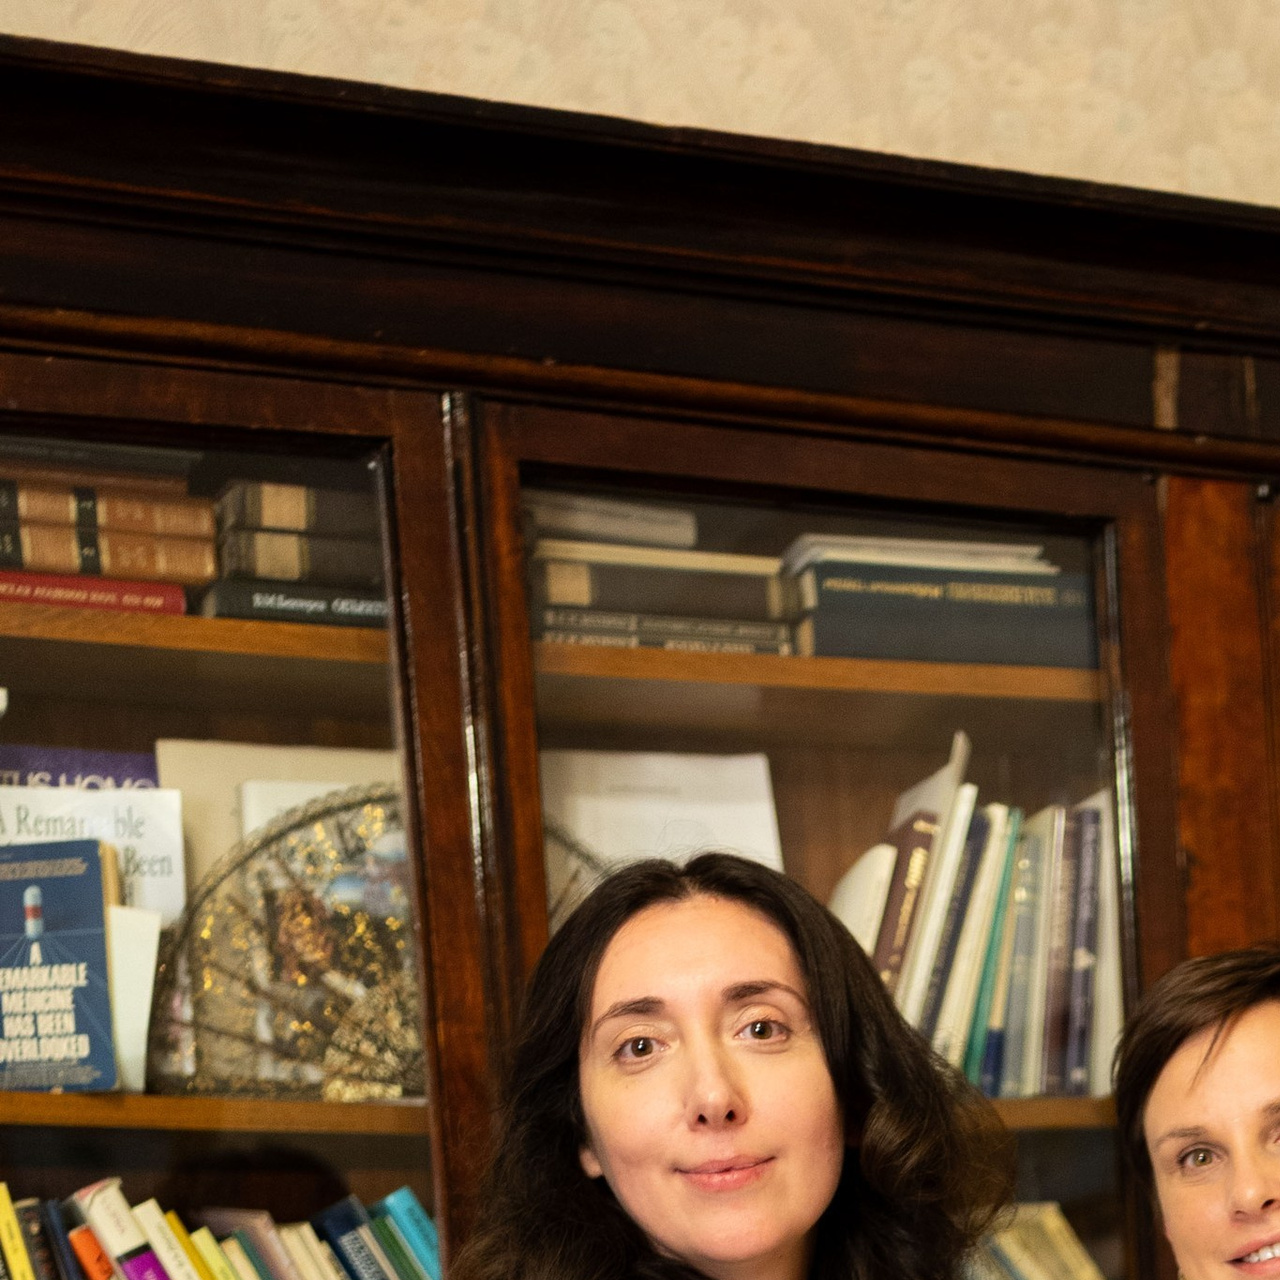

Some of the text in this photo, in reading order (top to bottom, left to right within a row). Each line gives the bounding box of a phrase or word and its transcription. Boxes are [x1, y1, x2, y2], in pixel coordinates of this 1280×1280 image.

[16, 805, 145, 839] Remarble
[124, 846, 173, 876] Been
[30, 941, 42, 965] A
[0, 962, 88, 990] EMARKABLE
[37, 1011, 75, 1036] BEEN
